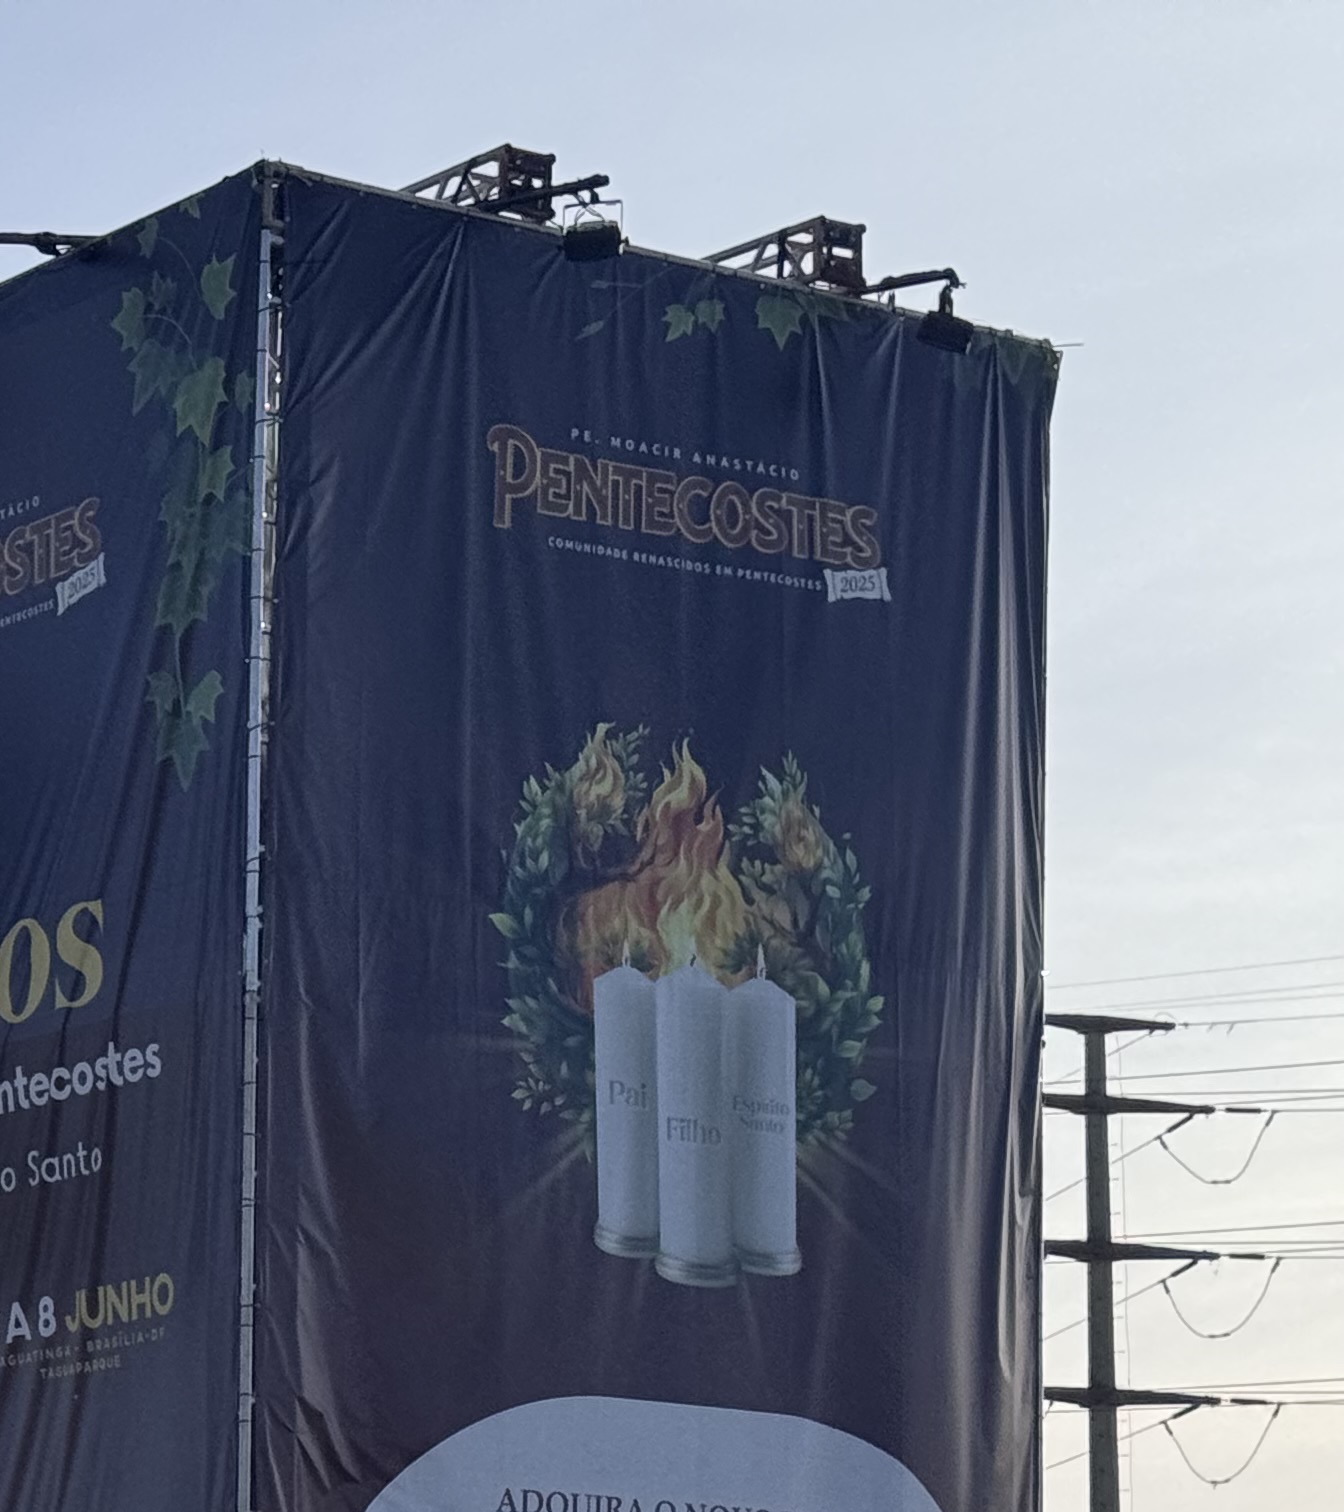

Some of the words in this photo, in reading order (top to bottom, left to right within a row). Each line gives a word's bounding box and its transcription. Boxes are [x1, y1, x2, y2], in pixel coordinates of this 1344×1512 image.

[570, 428, 600, 445] PE.
[610, 436, 682, 459] MOACIR
[692, 451, 801, 481] ANASTÁCIO
[486, 423, 881, 570] PENTECOSTES
[548, 536, 628, 561] COMUNIDADE
[633, 550, 711, 574] RENASCIDOS
[715, 563, 733, 577] EM
[737, 567, 823, 592] PENTECOSTES
[839, 574, 876, 593] 2025
[608, 1080, 647, 1109] Pai
[666, 1116, 722, 1145] Filho
[28, 1141, 102, 1187] Santo
[65, 1272, 175, 1333] JUNHO
